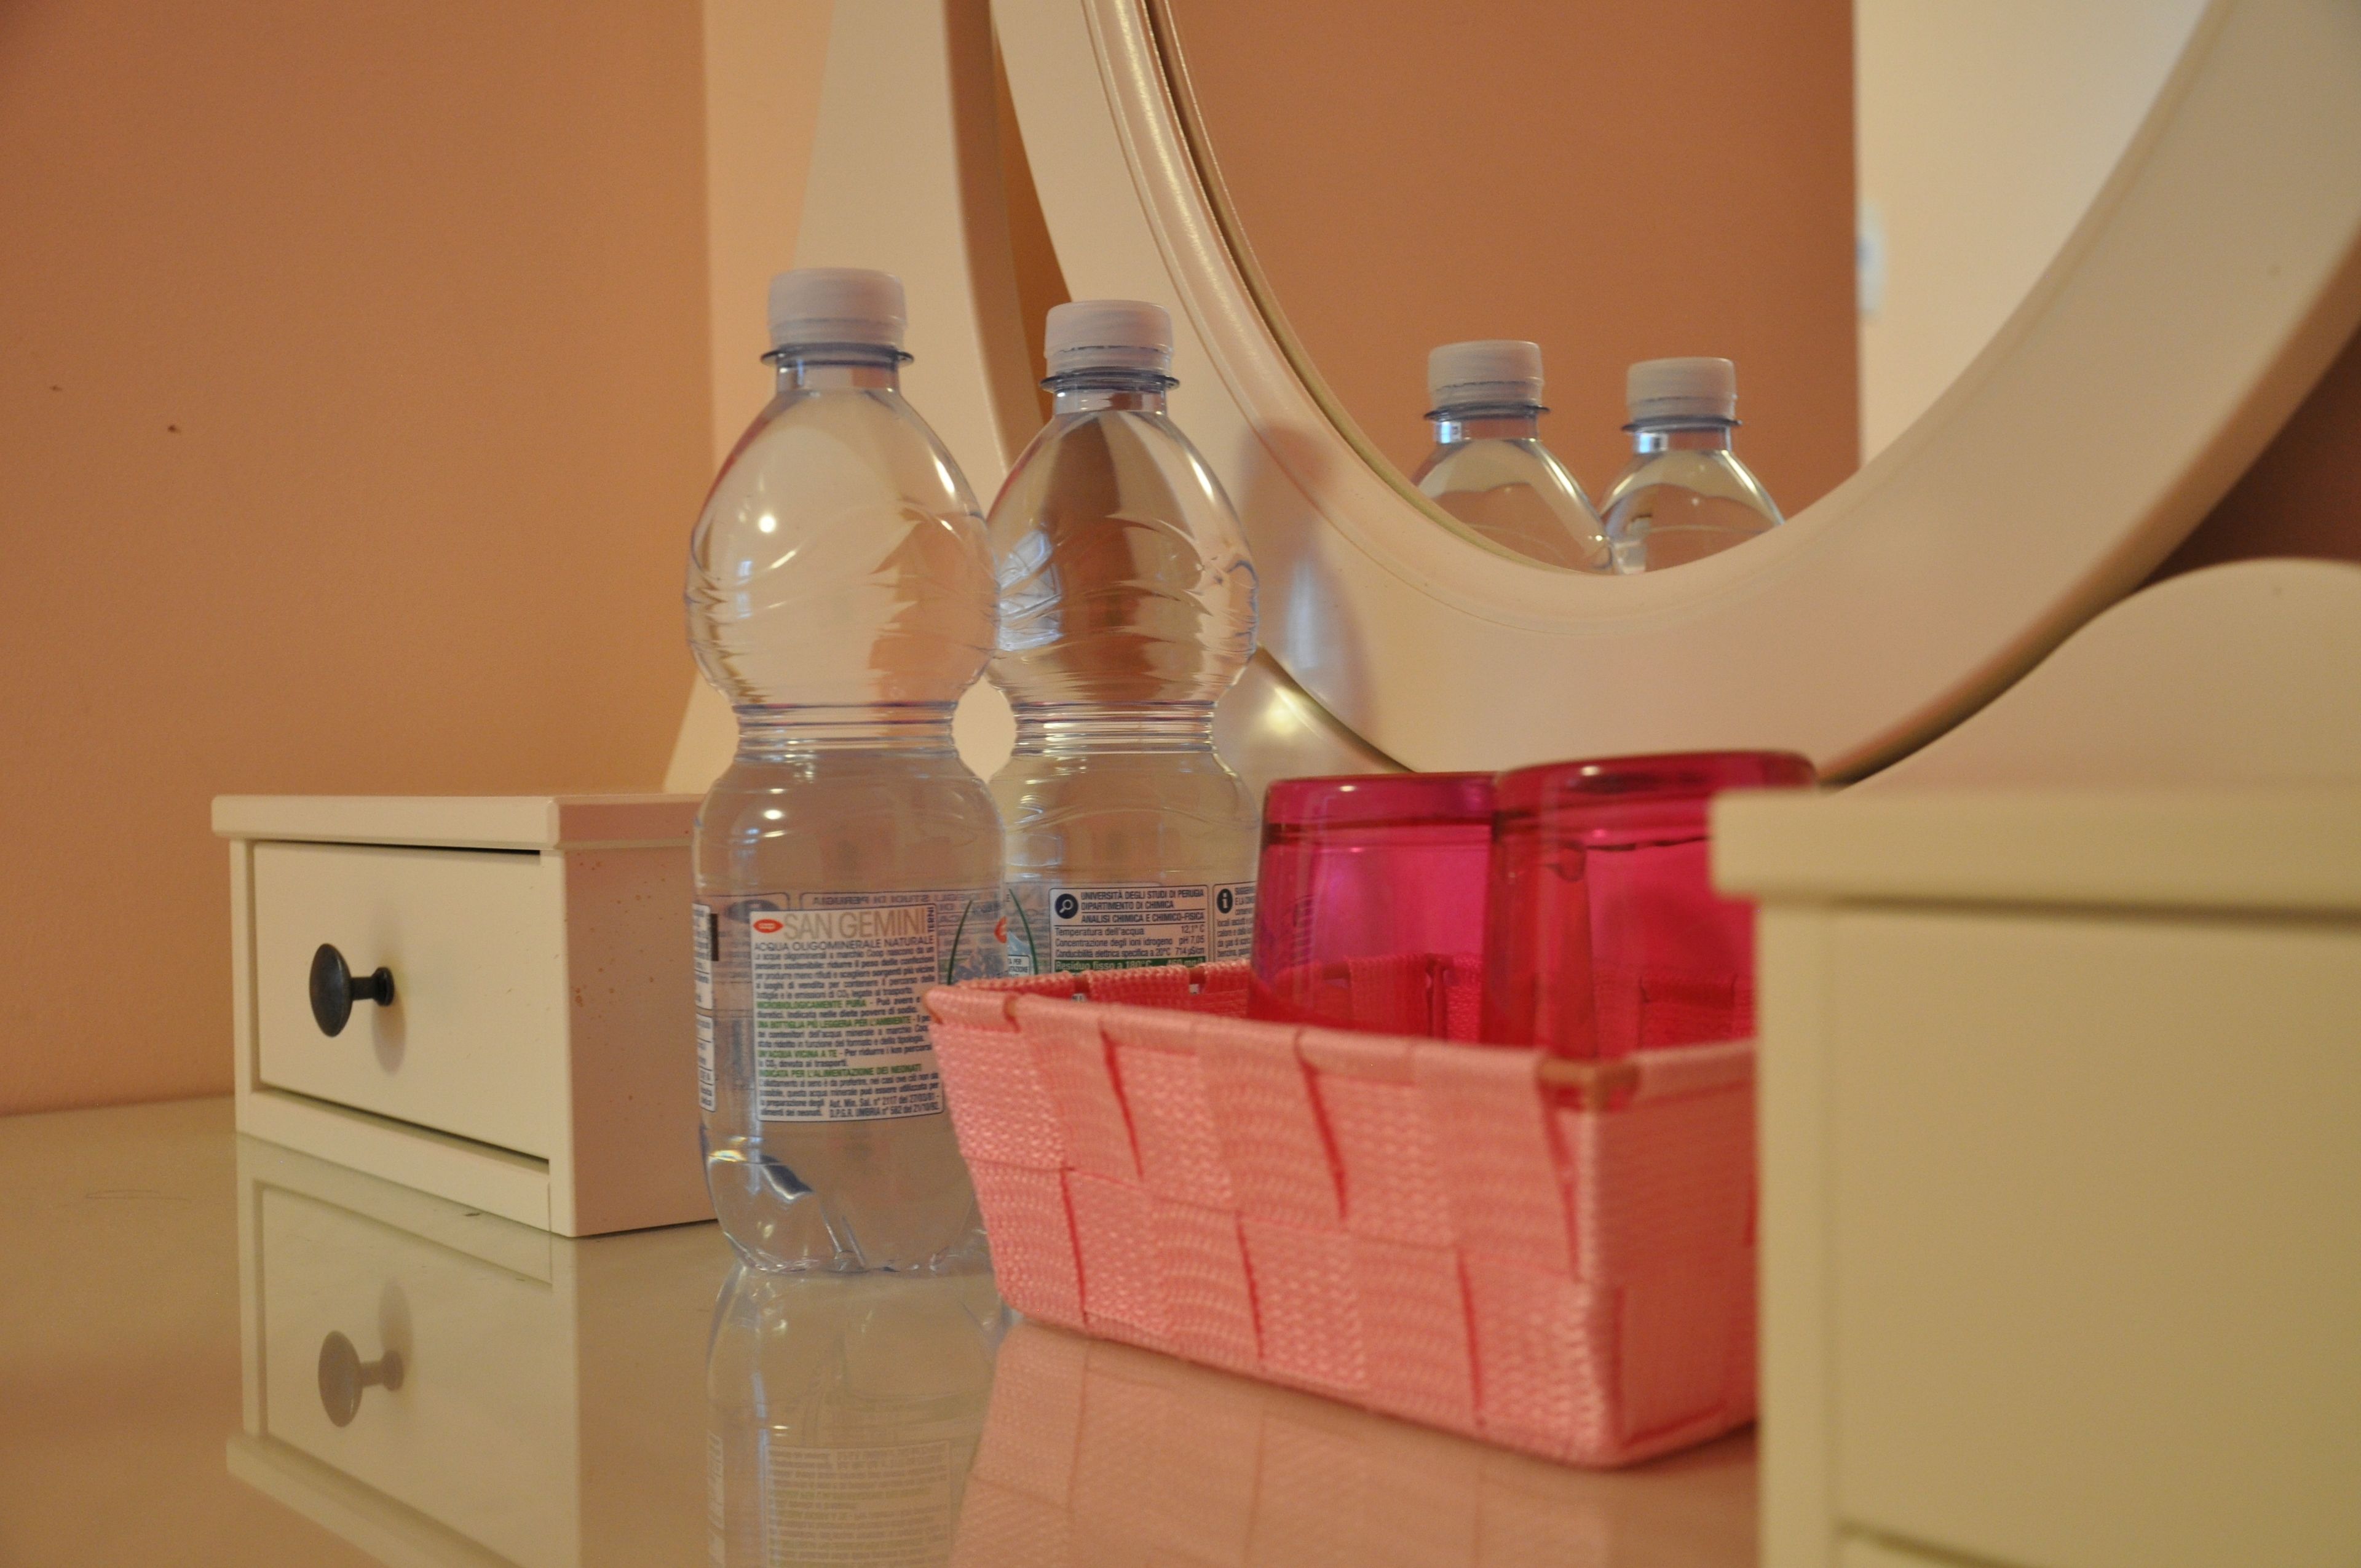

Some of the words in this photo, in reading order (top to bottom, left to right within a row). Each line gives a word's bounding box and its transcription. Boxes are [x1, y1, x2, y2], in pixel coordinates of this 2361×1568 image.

[1081, 890, 1123, 900] UNIVERSITÀ
[1124, 890, 1145, 900] DEGLI
[1147, 890, 1168, 899] STUDI
[1169, 890, 1176, 898] DI
[1177, 889, 1204, 898] PERUGIA
[1081, 901, 1134, 911] DIPARTIMENTO
[1135, 901, 1143, 909] DI
[1145, 900, 1174, 909] CHIMICA
[1082, 915, 1110, 924] ANALISI
[1112, 914, 1144, 923] CHIMICA
[1152, 912, 1204, 922] CHIMICO-FISICA
[784, 913, 833, 940] SAN
[839, 908, 926, 939] GEMINI
[1055, 927, 1103, 937] Temperatura
[1105, 927, 1145, 937] dell'acqua
[756, 942, 789, 951] ACQUA
[793, 939, 882, 951] OLIGOMINERALE
[884, 935, 934, 948] NATURALE
[1055, 938, 1109, 948] Concentrazione
[1110, 937, 1127, 948] degli
[1128, 938, 1142, 946] ioni
[1143, 936, 1173, 948] idrogeno
[1179, 936, 1189, 946] pH
[1056, 961, 1090, 970] Residuo
[1093, 960, 1116, 970] fisso
[844, 1048, 858, 1057] Per
[791, 1069, 805, 1078] PER
